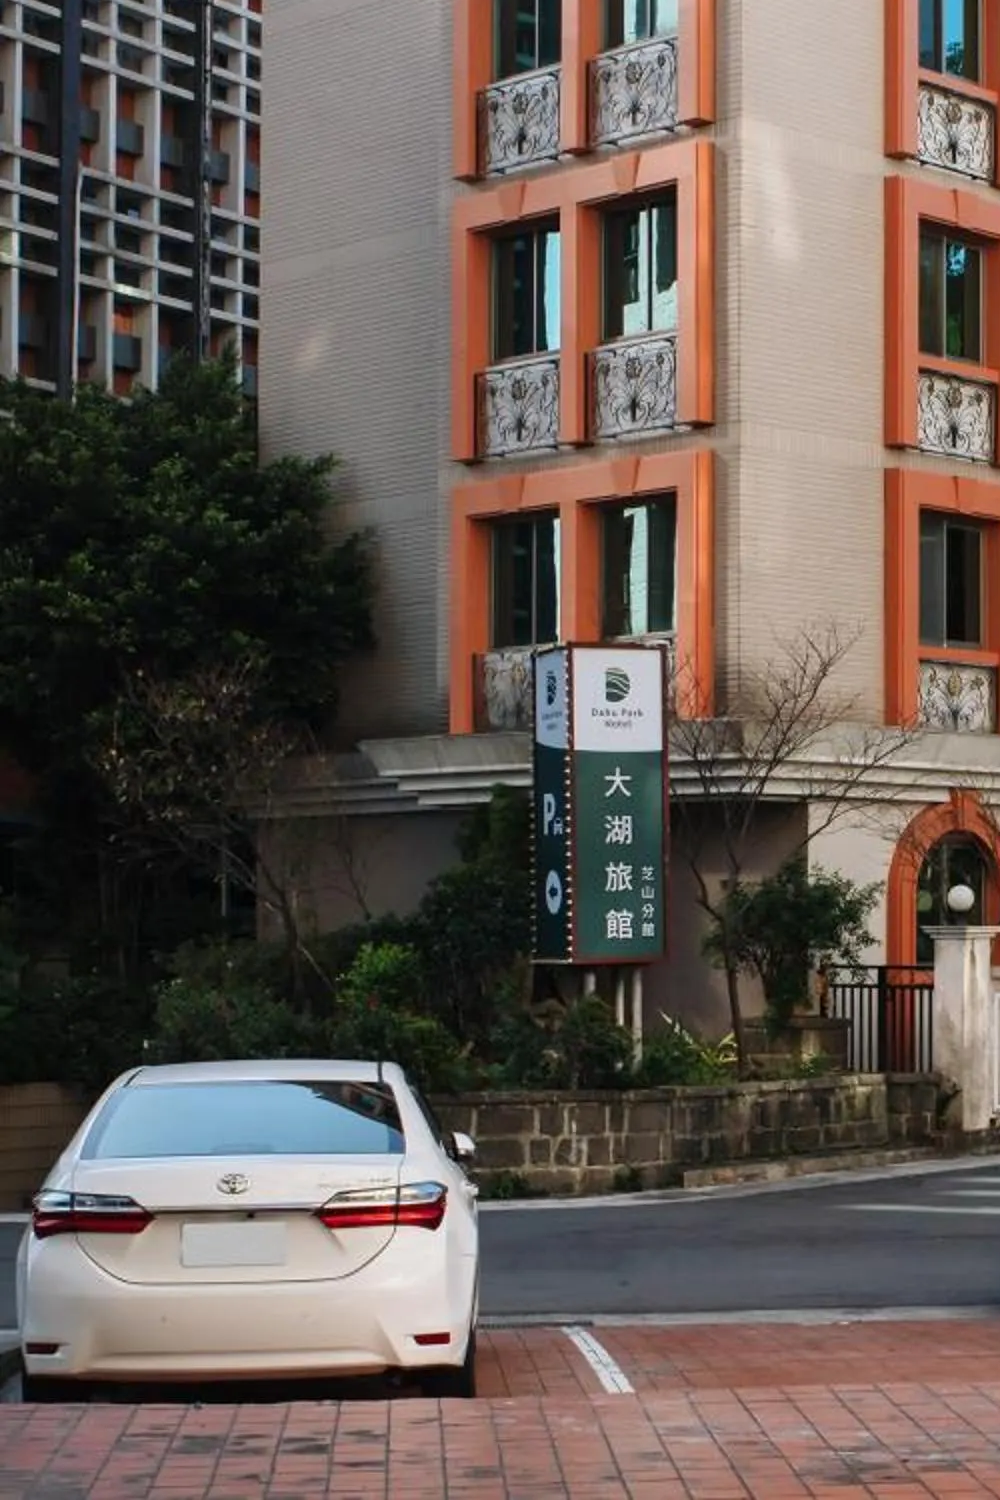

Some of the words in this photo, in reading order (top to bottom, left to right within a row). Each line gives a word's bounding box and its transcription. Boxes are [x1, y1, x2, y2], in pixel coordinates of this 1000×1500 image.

[543, 793, 556, 836] P
[604, 766, 634, 940] 大湖旅館
[641, 866, 655, 937] 芝山分館
